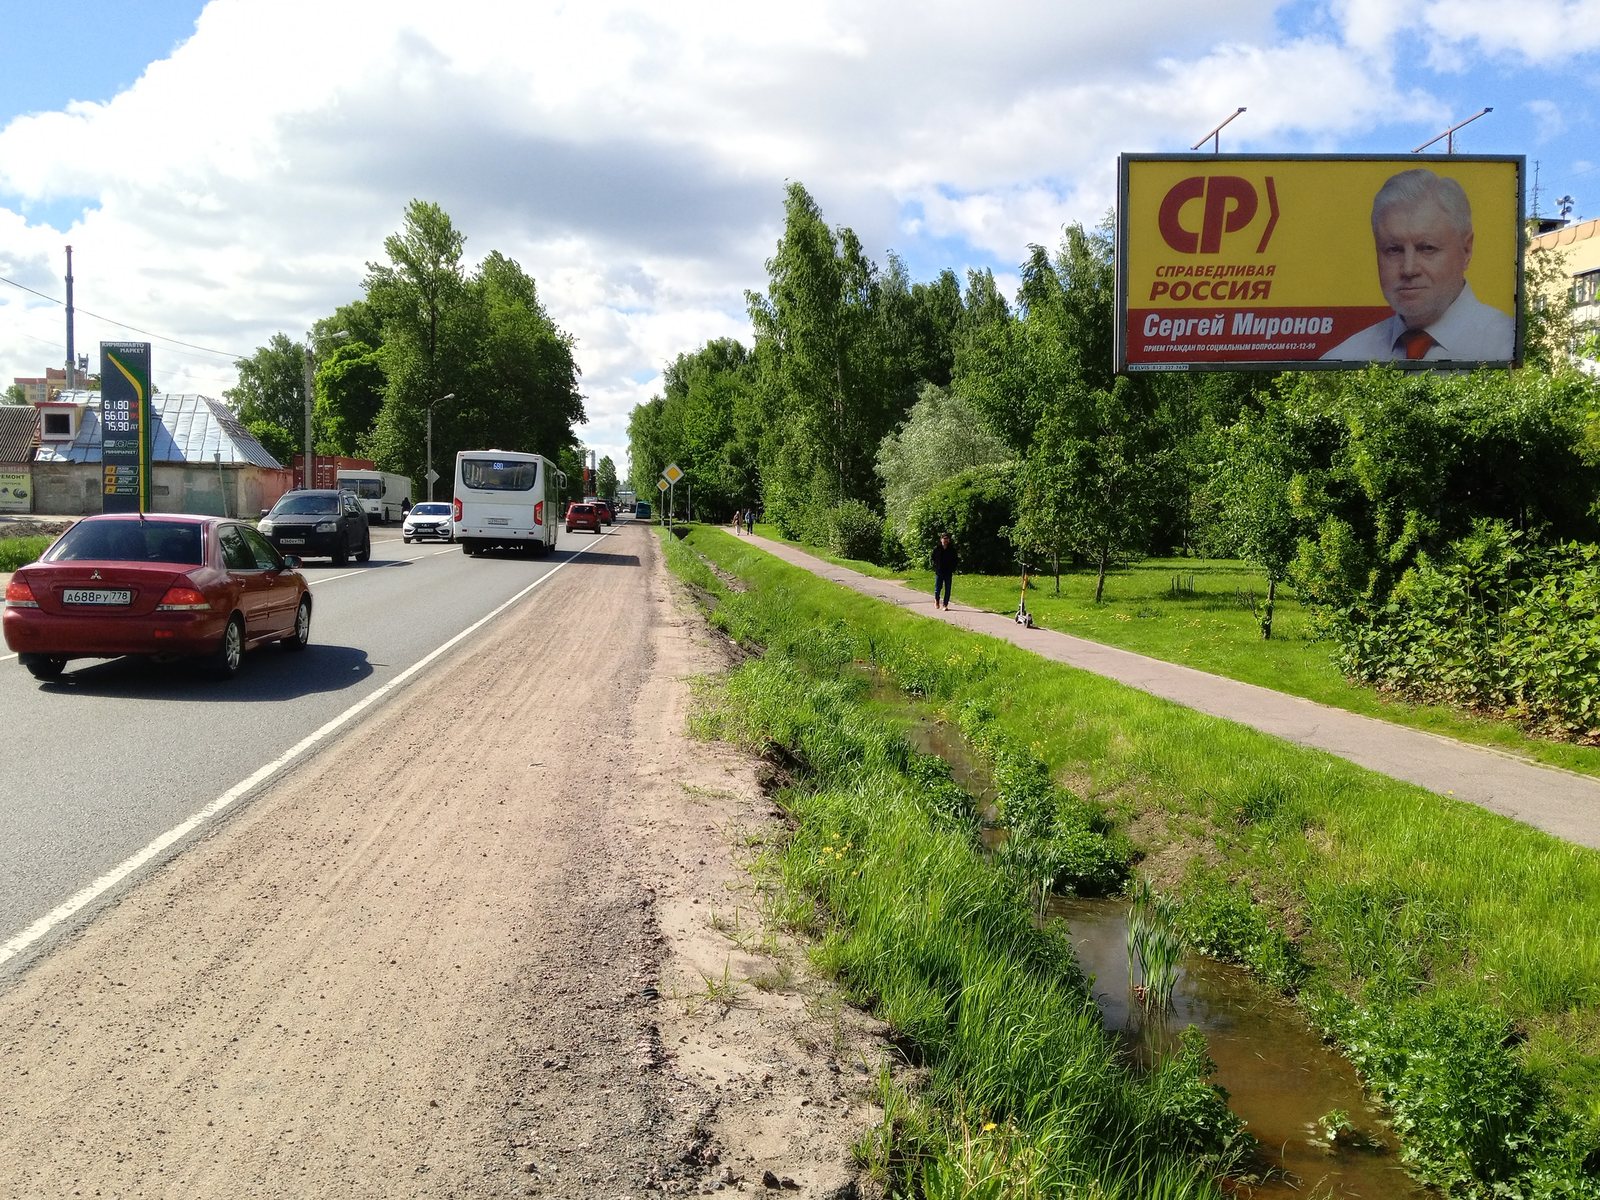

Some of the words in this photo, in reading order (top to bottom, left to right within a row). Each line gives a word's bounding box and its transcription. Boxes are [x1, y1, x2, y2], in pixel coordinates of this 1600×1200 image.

[1155, 265, 1277, 279] СПРАВЕДЛИВАЯ
[1149, 280, 1273, 301] РОССИЯ
[1143, 313, 1225, 341] Сергей
[1231, 312, 1334, 340] Миронов
[1166, 344, 1196, 353] ГРАЖДАН
[1206, 343, 1250, 352] СОЦИАЛЬНЫМ
[1251, 343, 1285, 351] ВОПРОСАМ
[1285, 342, 1316, 350] 612-12-90
[104, 400, 129, 410] 61.80
[104, 411, 130, 421] 66.00
[105, 421, 130, 431] 75.90
[66, 591, 109, 602] А688РУ
[111, 591, 128, 600] 778
